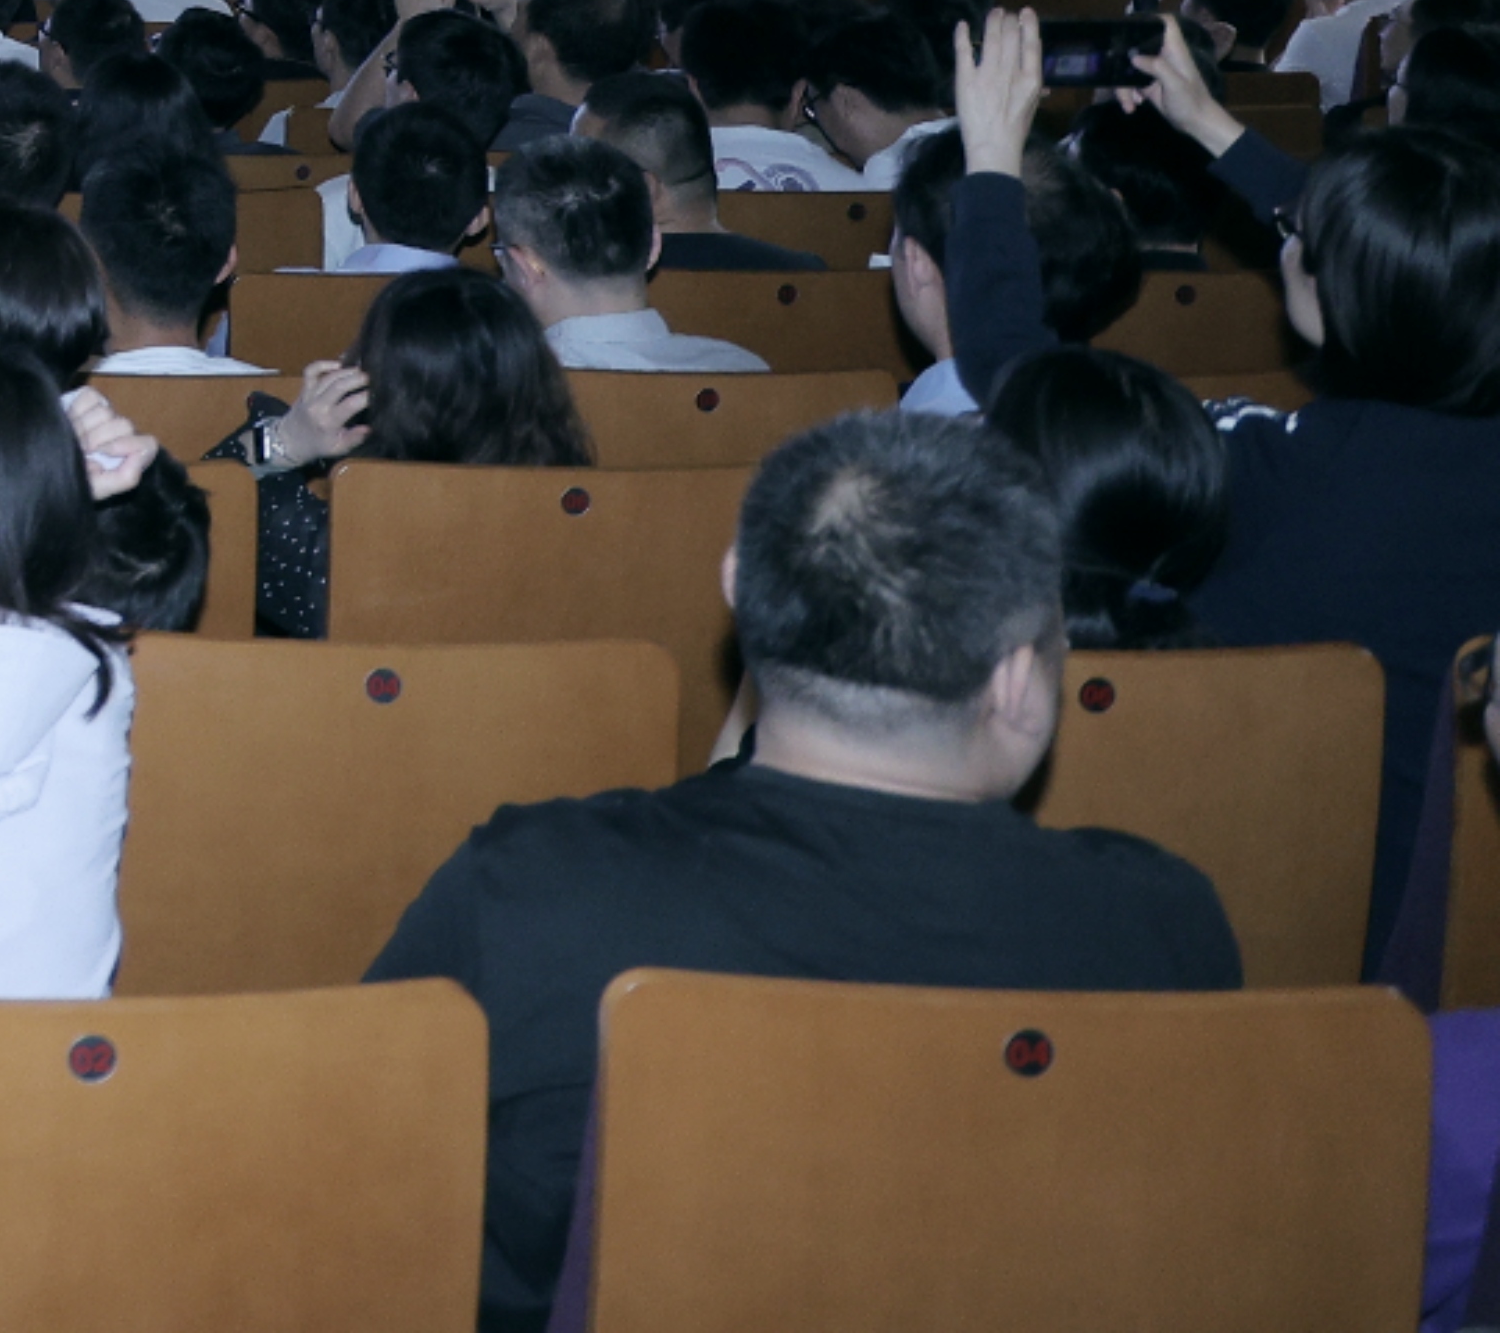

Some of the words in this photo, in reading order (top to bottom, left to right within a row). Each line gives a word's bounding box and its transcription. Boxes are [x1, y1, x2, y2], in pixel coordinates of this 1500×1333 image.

[365, 675, 400, 697] 04
[69, 1044, 114, 1074] 02
[1005, 1040, 1052, 1070] 04
